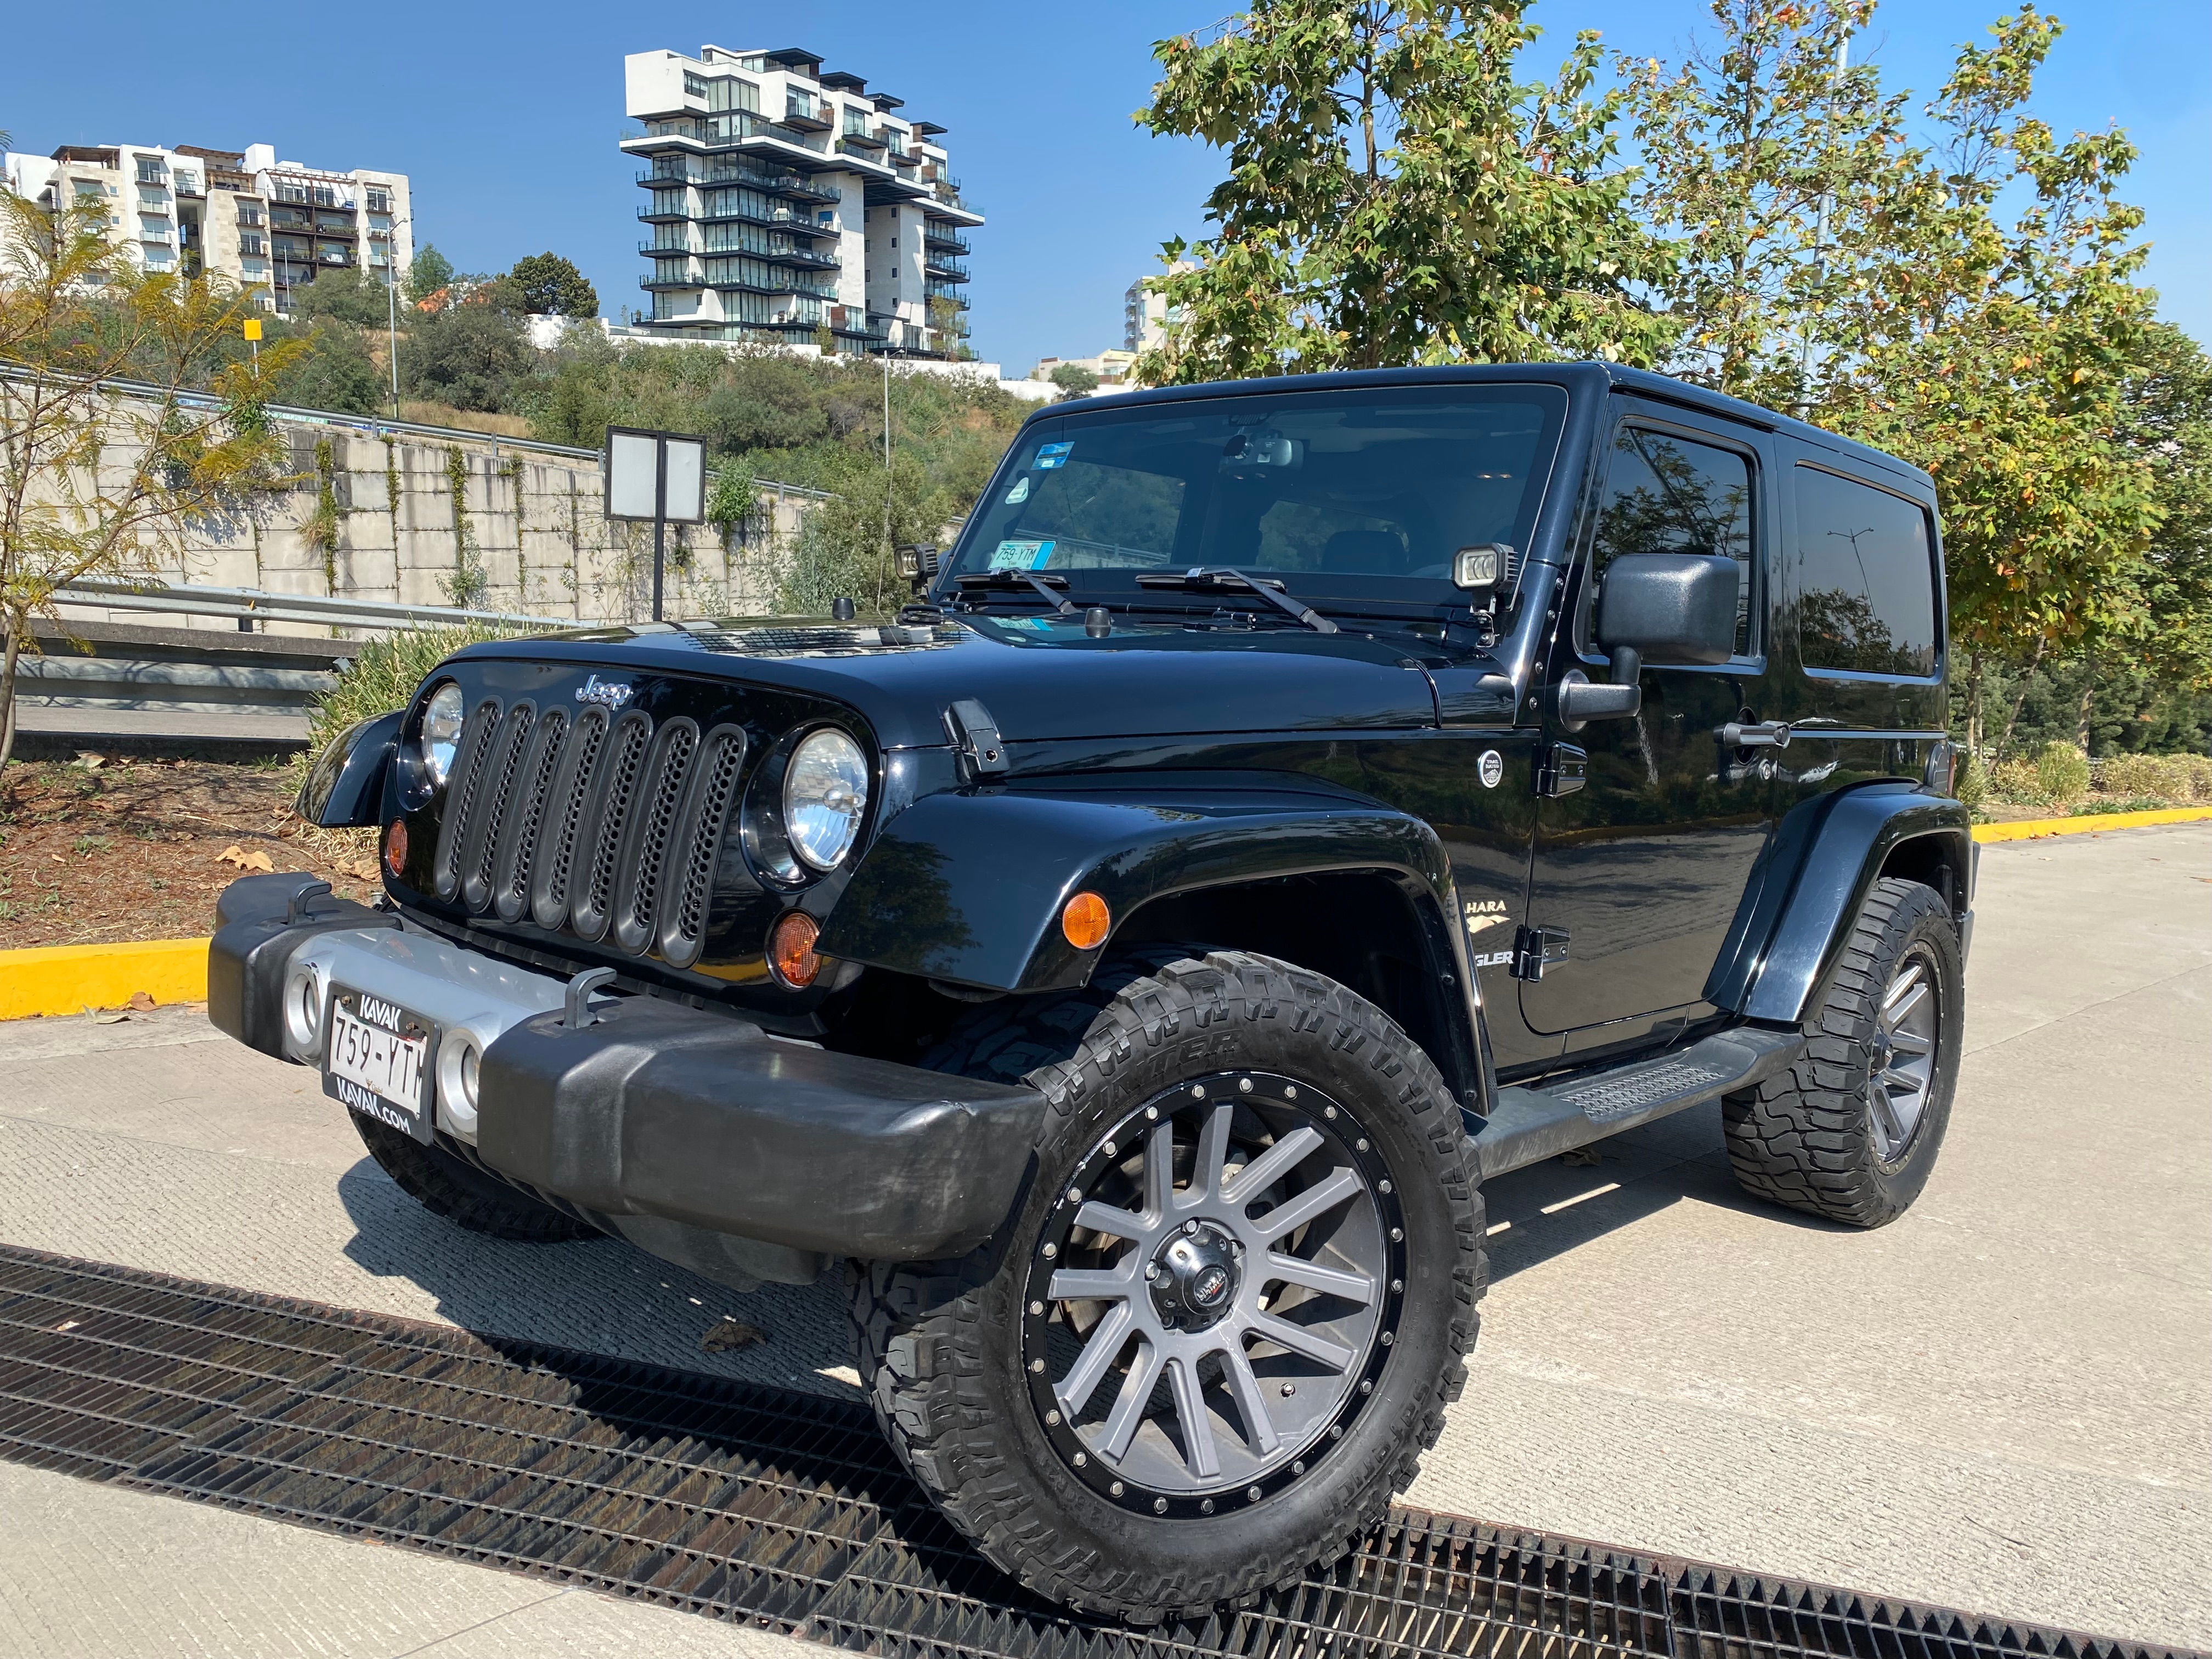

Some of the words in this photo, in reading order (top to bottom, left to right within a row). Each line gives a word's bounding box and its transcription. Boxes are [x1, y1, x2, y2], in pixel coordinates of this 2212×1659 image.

[996, 548, 1037, 561] 759-YTM
[575, 674, 631, 712] Jeep
[1464, 900, 1506, 913] HARA
[1475, 950, 1514, 967] GLER
[359, 994, 402, 1032] KAVAK
[336, 1076, 411, 1135] KAVAK.COM
